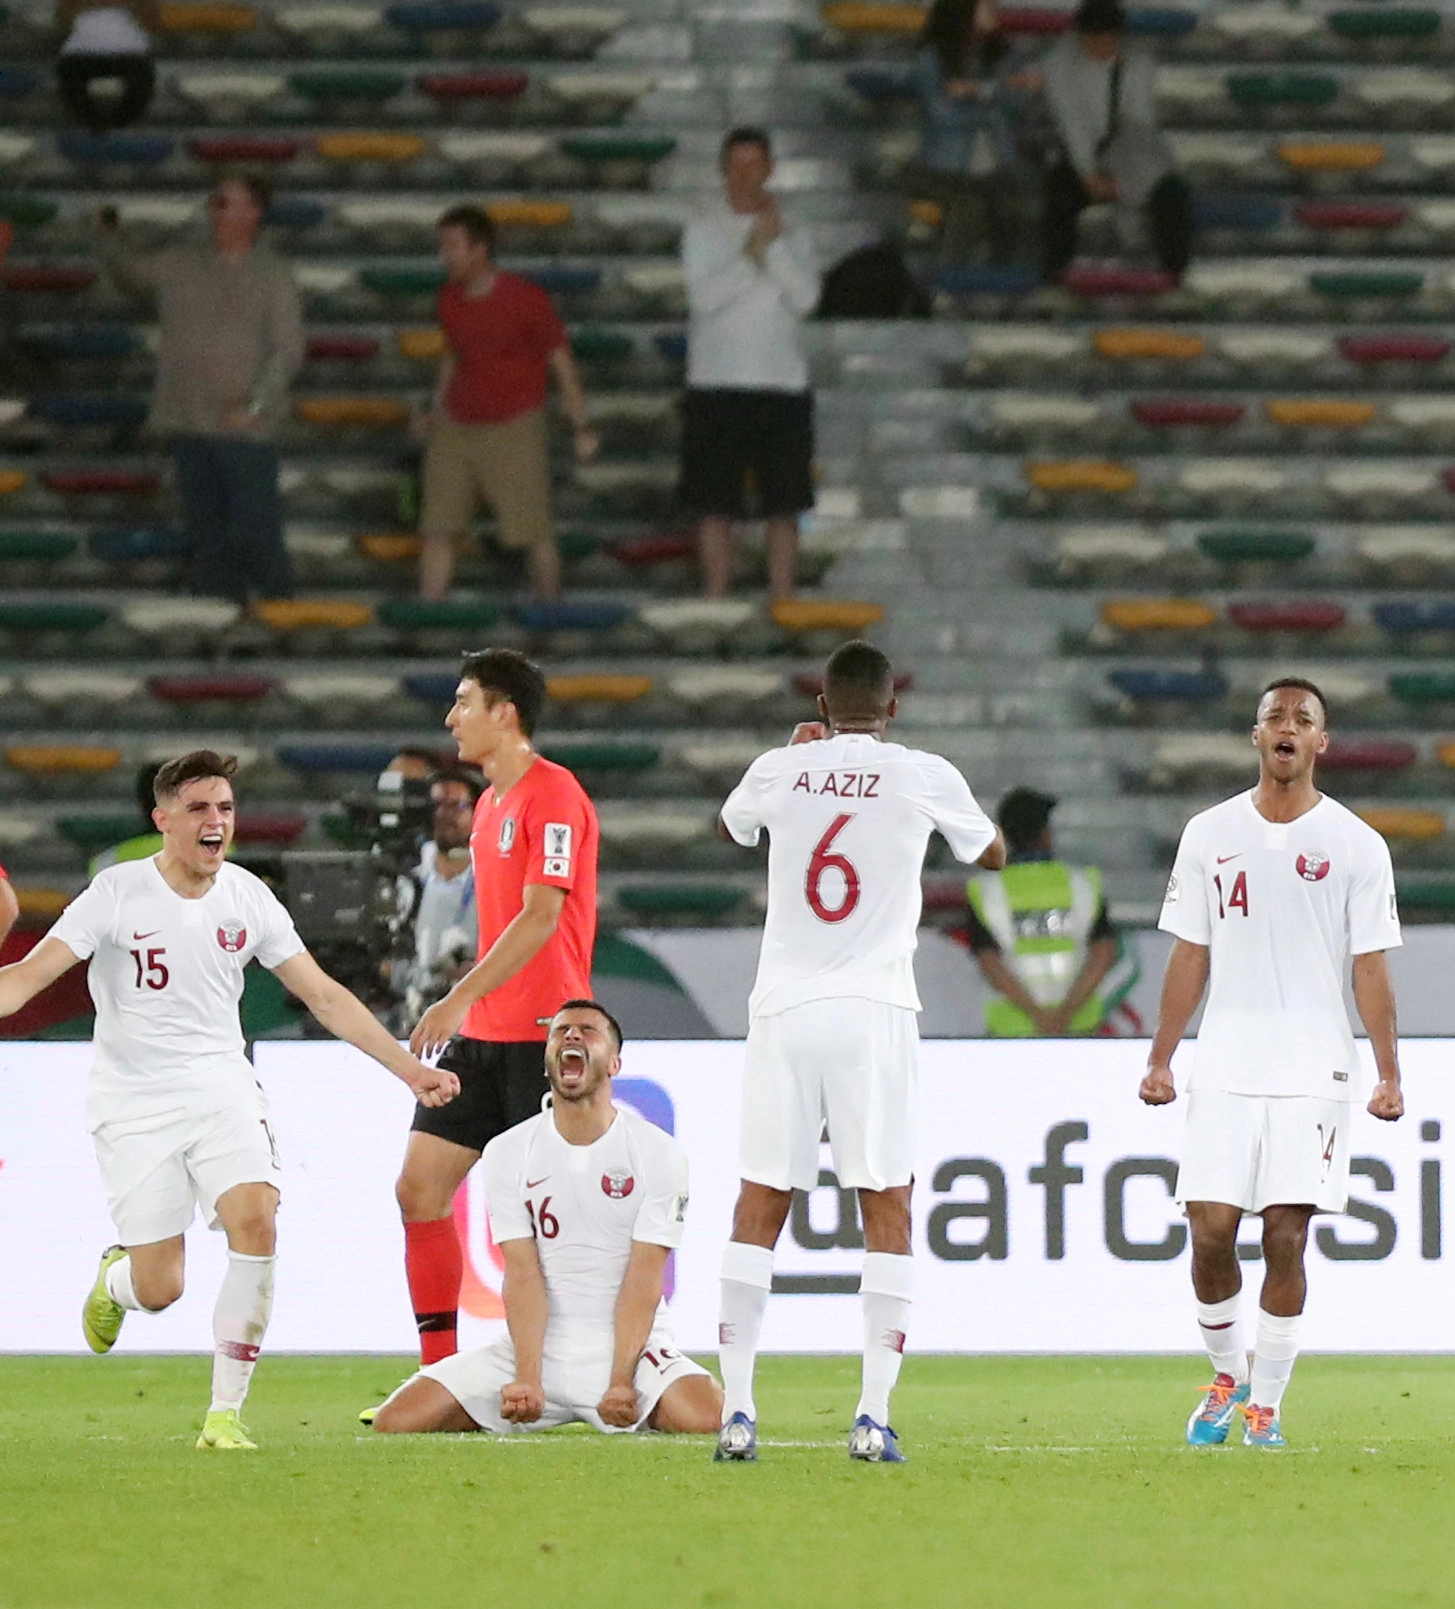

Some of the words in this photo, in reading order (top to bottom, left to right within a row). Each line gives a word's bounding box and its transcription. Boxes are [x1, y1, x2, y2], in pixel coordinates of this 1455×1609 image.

[792, 771, 881, 798] A.AZIZ
[804, 811, 860, 924] 6
[1213, 871, 1249, 919] 14
[129, 948, 169, 990] 15
[524, 1195, 559, 1240] 16
